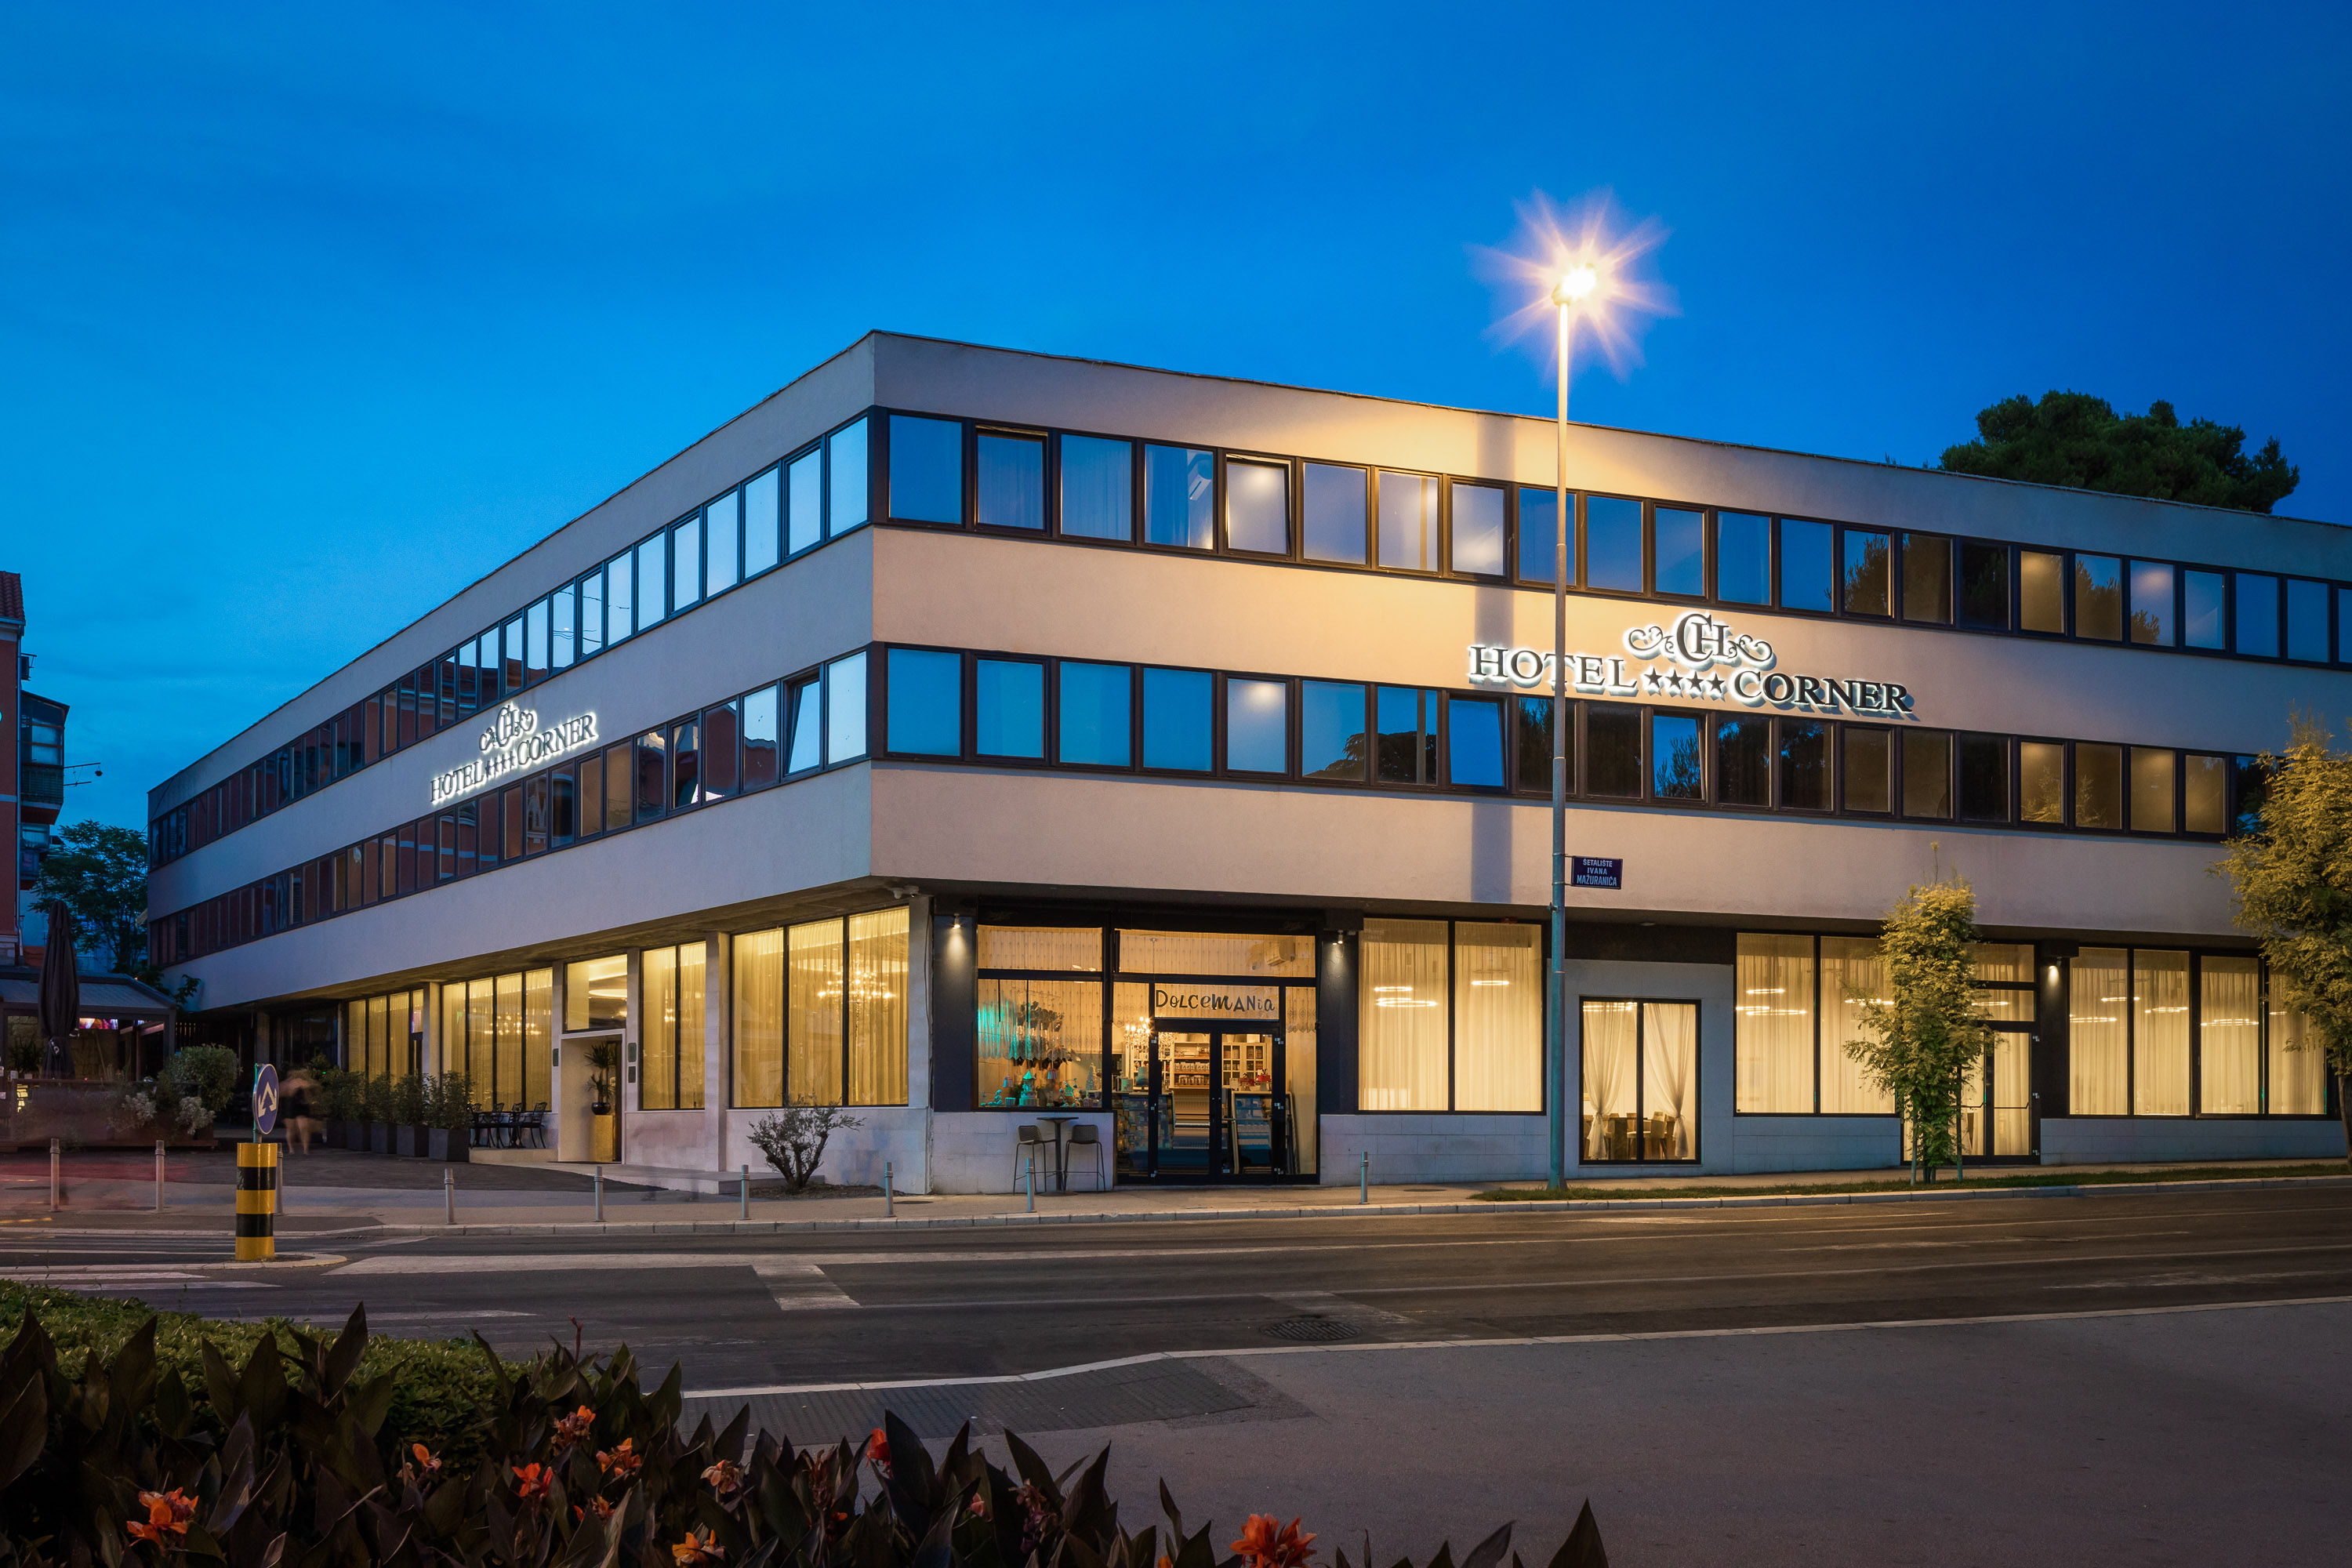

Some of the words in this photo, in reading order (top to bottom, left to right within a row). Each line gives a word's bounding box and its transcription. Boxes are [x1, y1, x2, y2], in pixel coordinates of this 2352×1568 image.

[1734, 670, 1912, 713] CORNER
[430, 761, 484, 802] HOTEL
[517, 714, 596, 765] CORNER
